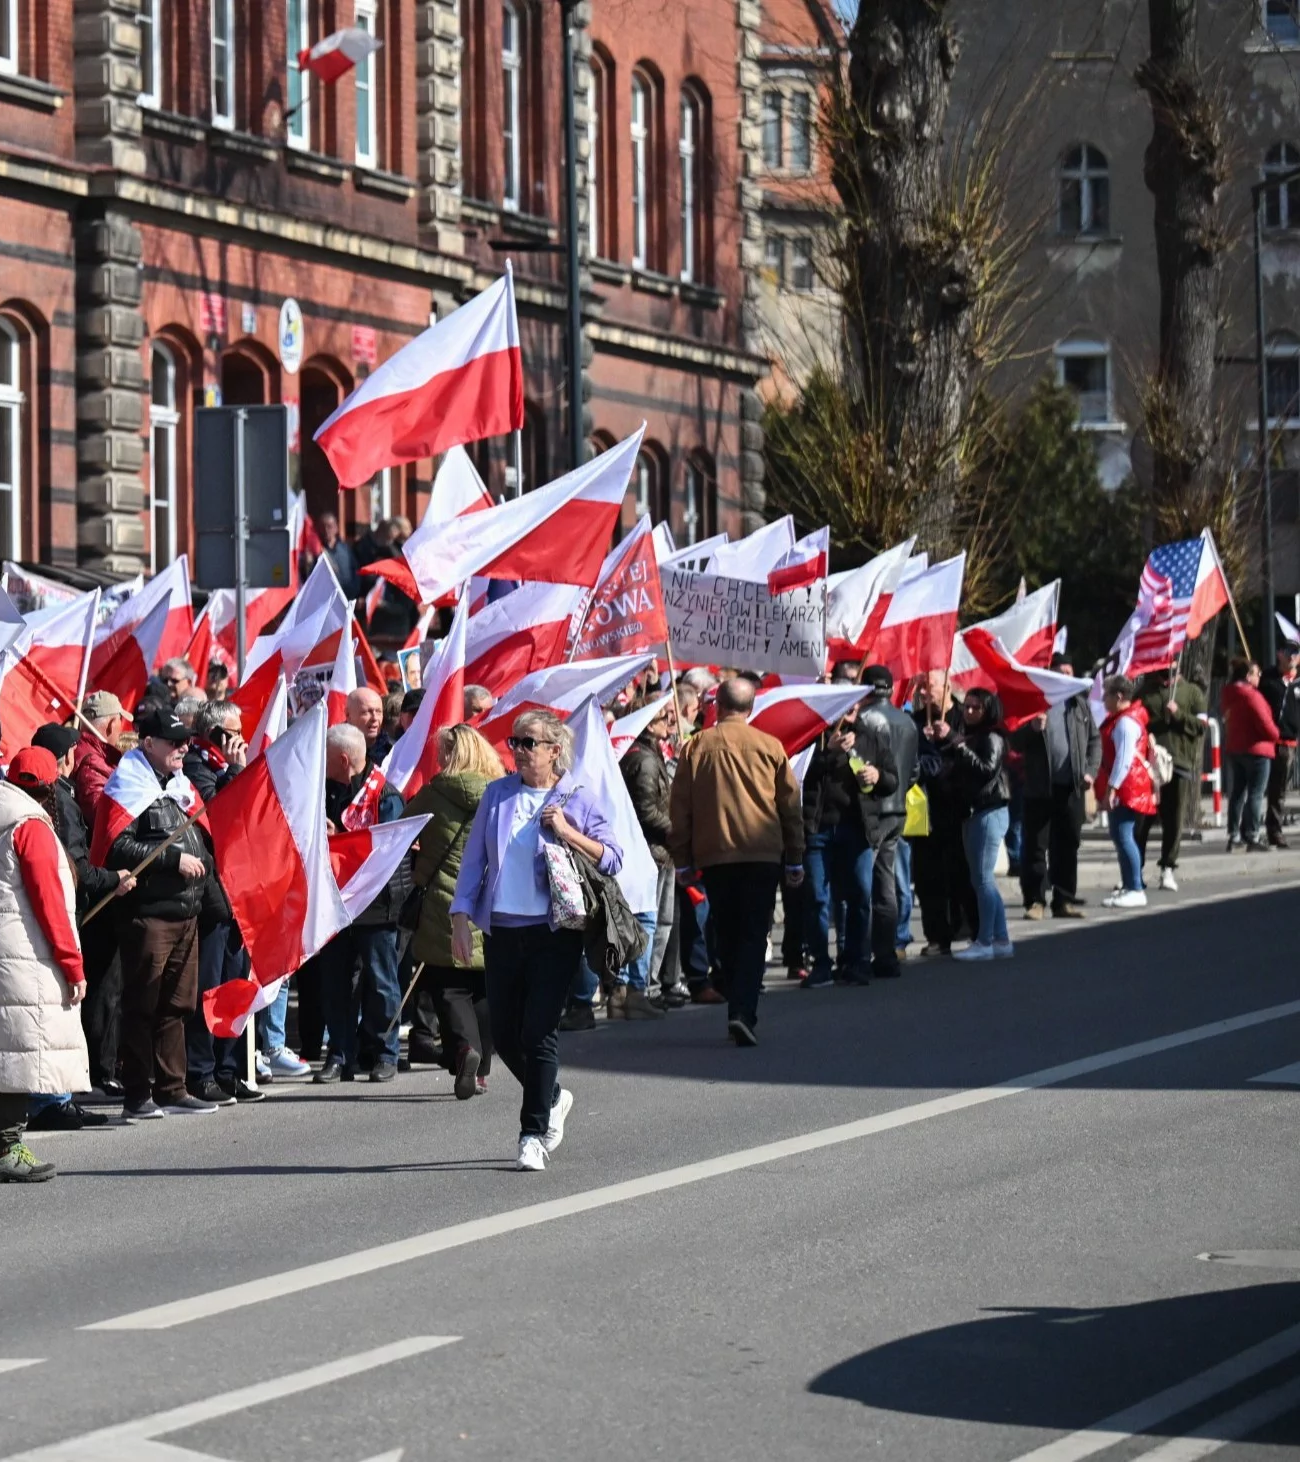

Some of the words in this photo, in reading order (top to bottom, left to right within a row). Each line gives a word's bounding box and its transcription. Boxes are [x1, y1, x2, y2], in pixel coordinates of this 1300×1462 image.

[672, 571, 701, 593] NIE
[664, 588, 751, 618] NŻYNIERÓW
[764, 604, 825, 623] LEKARZY
[683, 610, 694, 627] Z
[707, 614, 775, 638] NIEMIEC
[697, 631, 756, 652] SWOICH
[779, 641, 821, 658] AMEN
